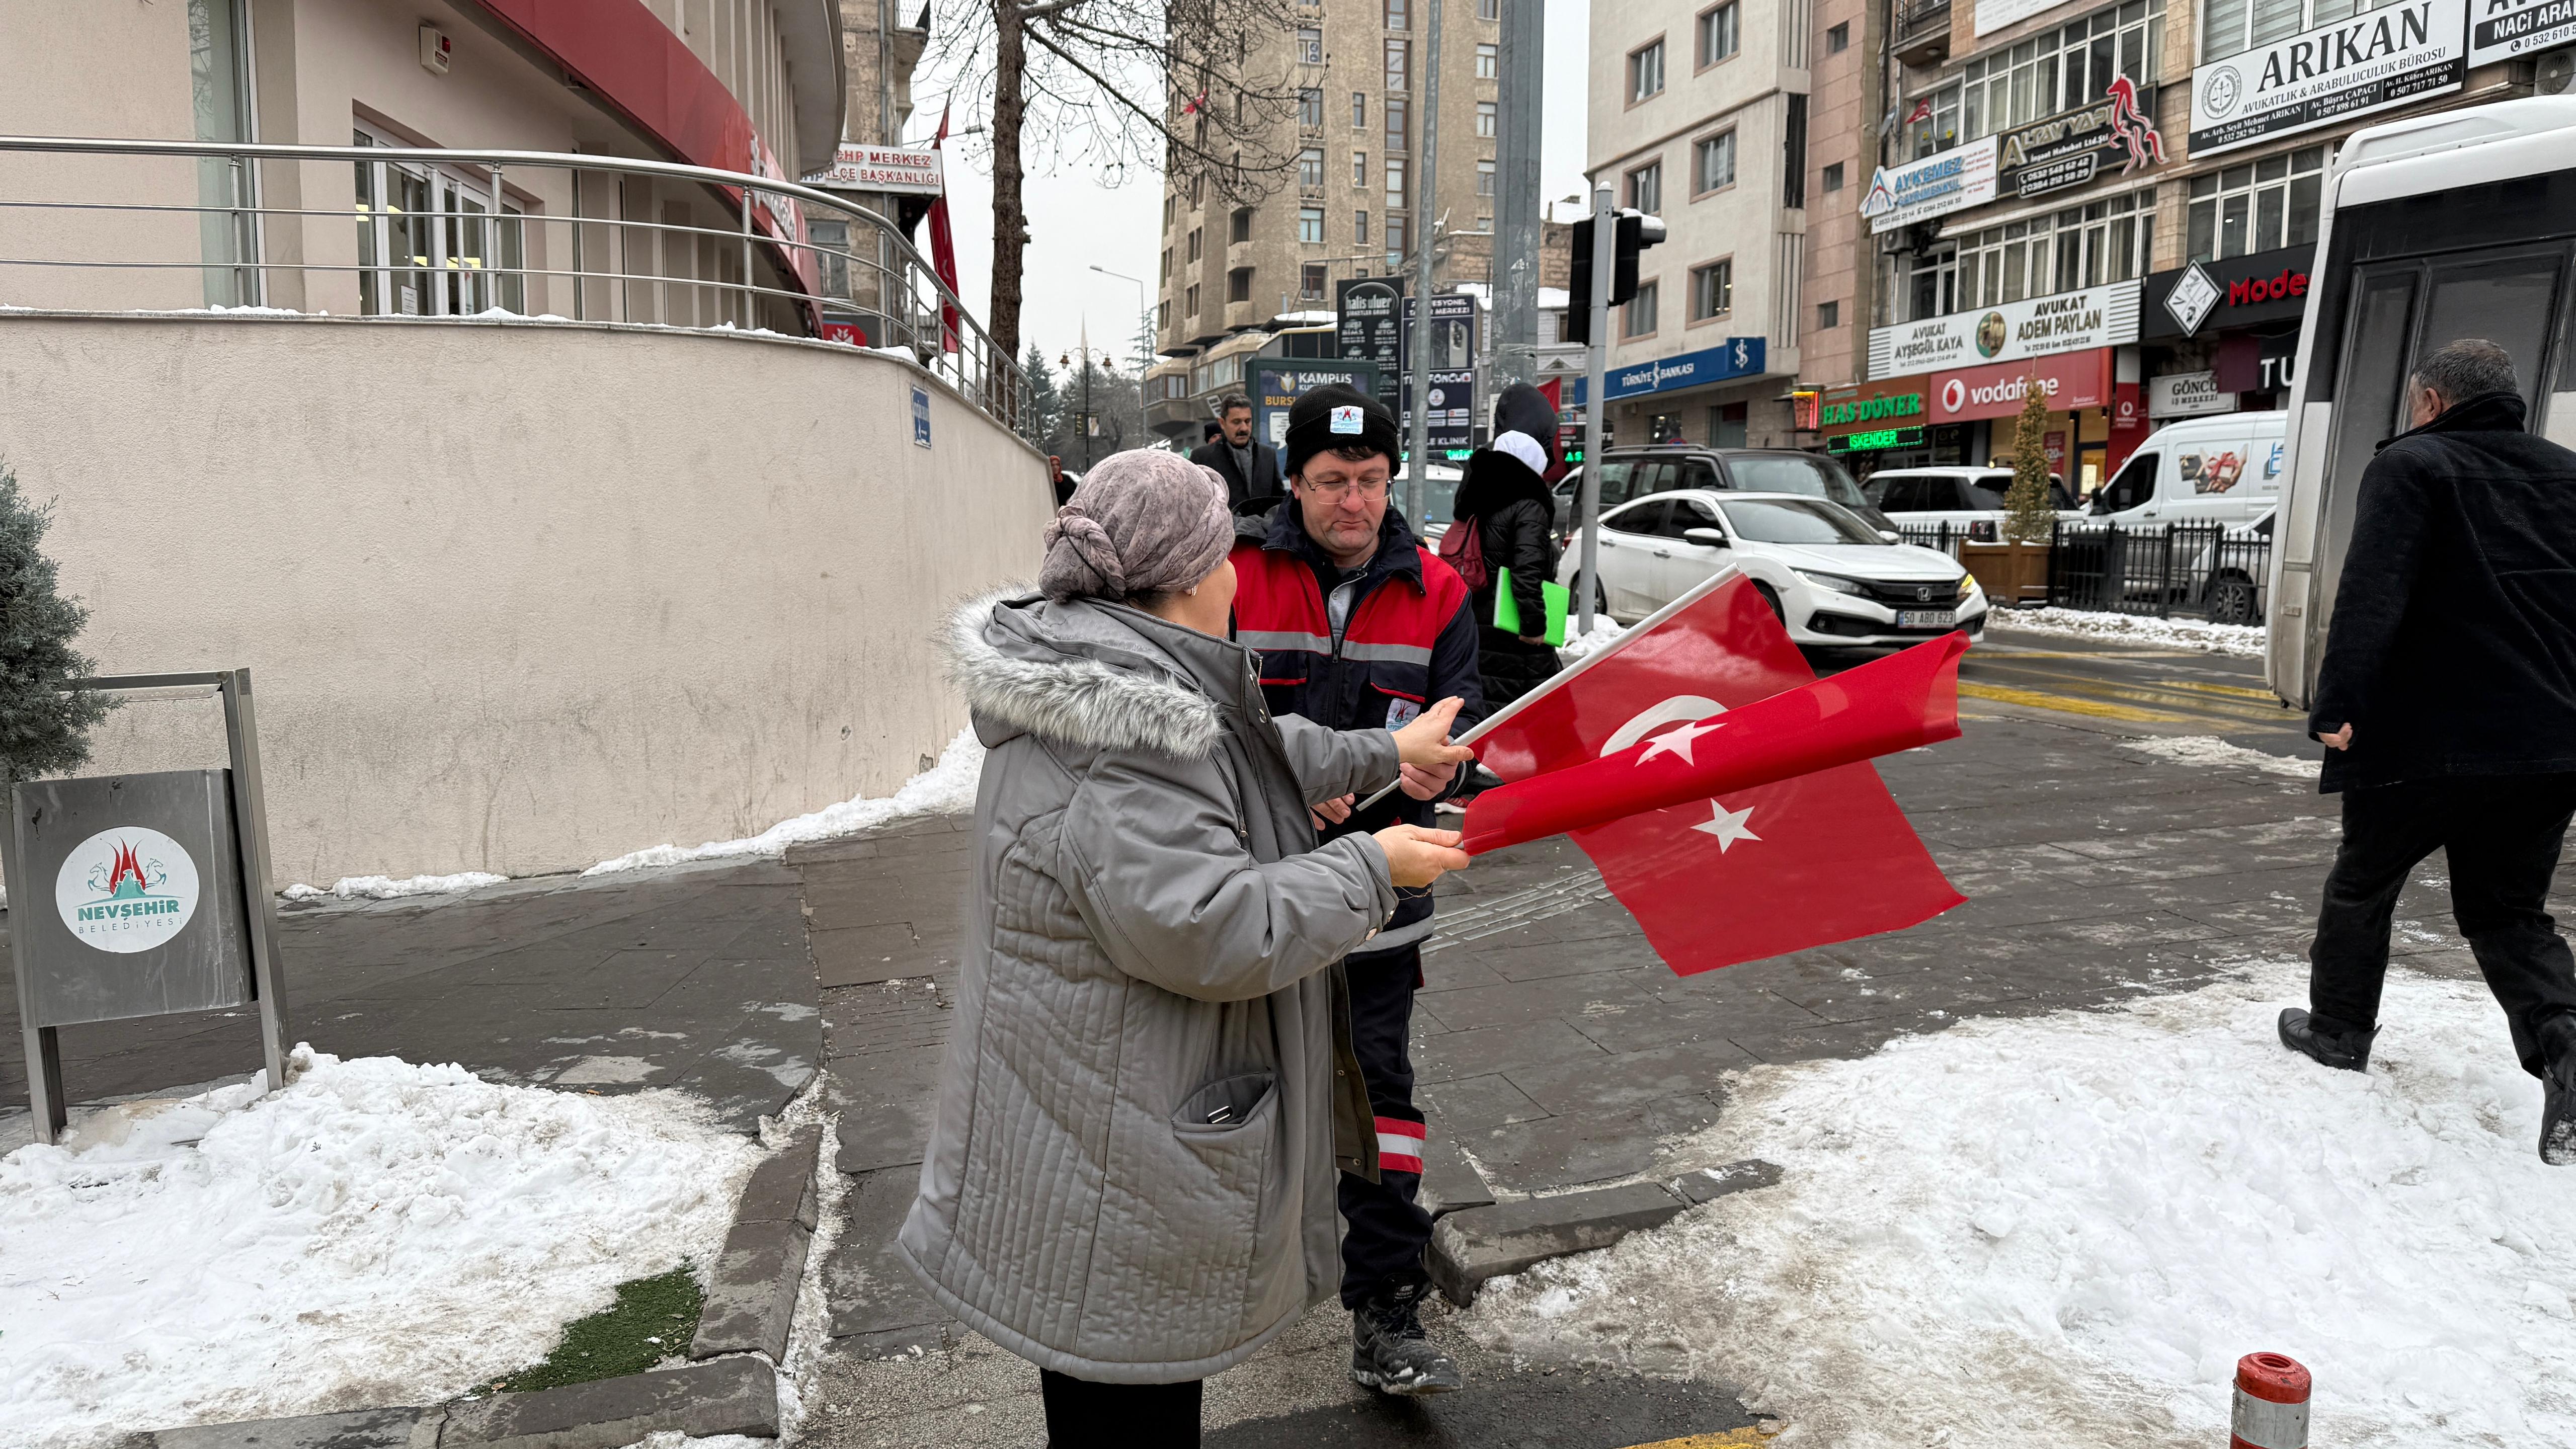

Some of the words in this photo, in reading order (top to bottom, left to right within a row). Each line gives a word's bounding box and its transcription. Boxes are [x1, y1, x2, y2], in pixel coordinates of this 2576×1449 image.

[2257, 1, 2432, 93] ARIKAN
[2525, 38, 2530, 48] 0
[2533, 32, 2549, 45] 532
[2552, 27, 2568, 40] 610
[2424, 62, 2454, 77] ARIKAN
[2242, 90, 2297, 115] AVUKATLIK
[2300, 87, 2307, 98] &
[2309, 61, 2396, 96] ARABULUCULUK
[2399, 46, 2446, 69] BÜROSU
[2390, 89, 2395, 97] 0
[2396, 85, 2409, 96] 507
[2412, 80, 2426, 92] 717
[2428, 77, 2436, 88] 71
[2438, 74, 2448, 85] 50
[2345, 84, 2377, 101] ÇAPACI
[2243, 115, 2270, 128] Mehmet
[2270, 105, 2302, 121] ARIKAN
[2317, 109, 2321, 117] 0
[2322, 106, 2336, 115] 507
[2337, 101, 2350, 112] 898
[2351, 99, 2359, 108] 61
[2360, 96, 2369, 106] 91
[2218, 136, 2223, 144] 0
[2223, 132, 2235, 142] 532
[2248, 126, 2257, 136] 96
[2257, 124, 2265, 133] 21
[869, 152, 932, 167] MERKEZ
[860, 169, 940, 185] BAŞKANLIĞI
[1895, 155, 1963, 192] AYKEMEZ
[2229, 268, 2313, 306] Mode
[1345, 295, 1366, 309] halis
[2035, 295, 2087, 317] AVUKAT
[1912, 323, 1946, 340] AVUKAT
[2017, 317, 2052, 342] ADEM
[2054, 308, 2102, 336] PAYLAN
[1895, 339, 1935, 359] AYŞEGÜL
[1937, 335, 1963, 352] KAYA
[1299, 372, 1352, 384] KAMPÜS
[1622, 370, 1652, 387] TÜRKİYE
[1660, 363, 1695, 379] BANKASI
[1823, 401, 1857, 426] HAS
[1859, 392, 1921, 421] DÖNER
[1904, 612, 1914, 623] 50
[1938, 612, 1953, 623] 623
